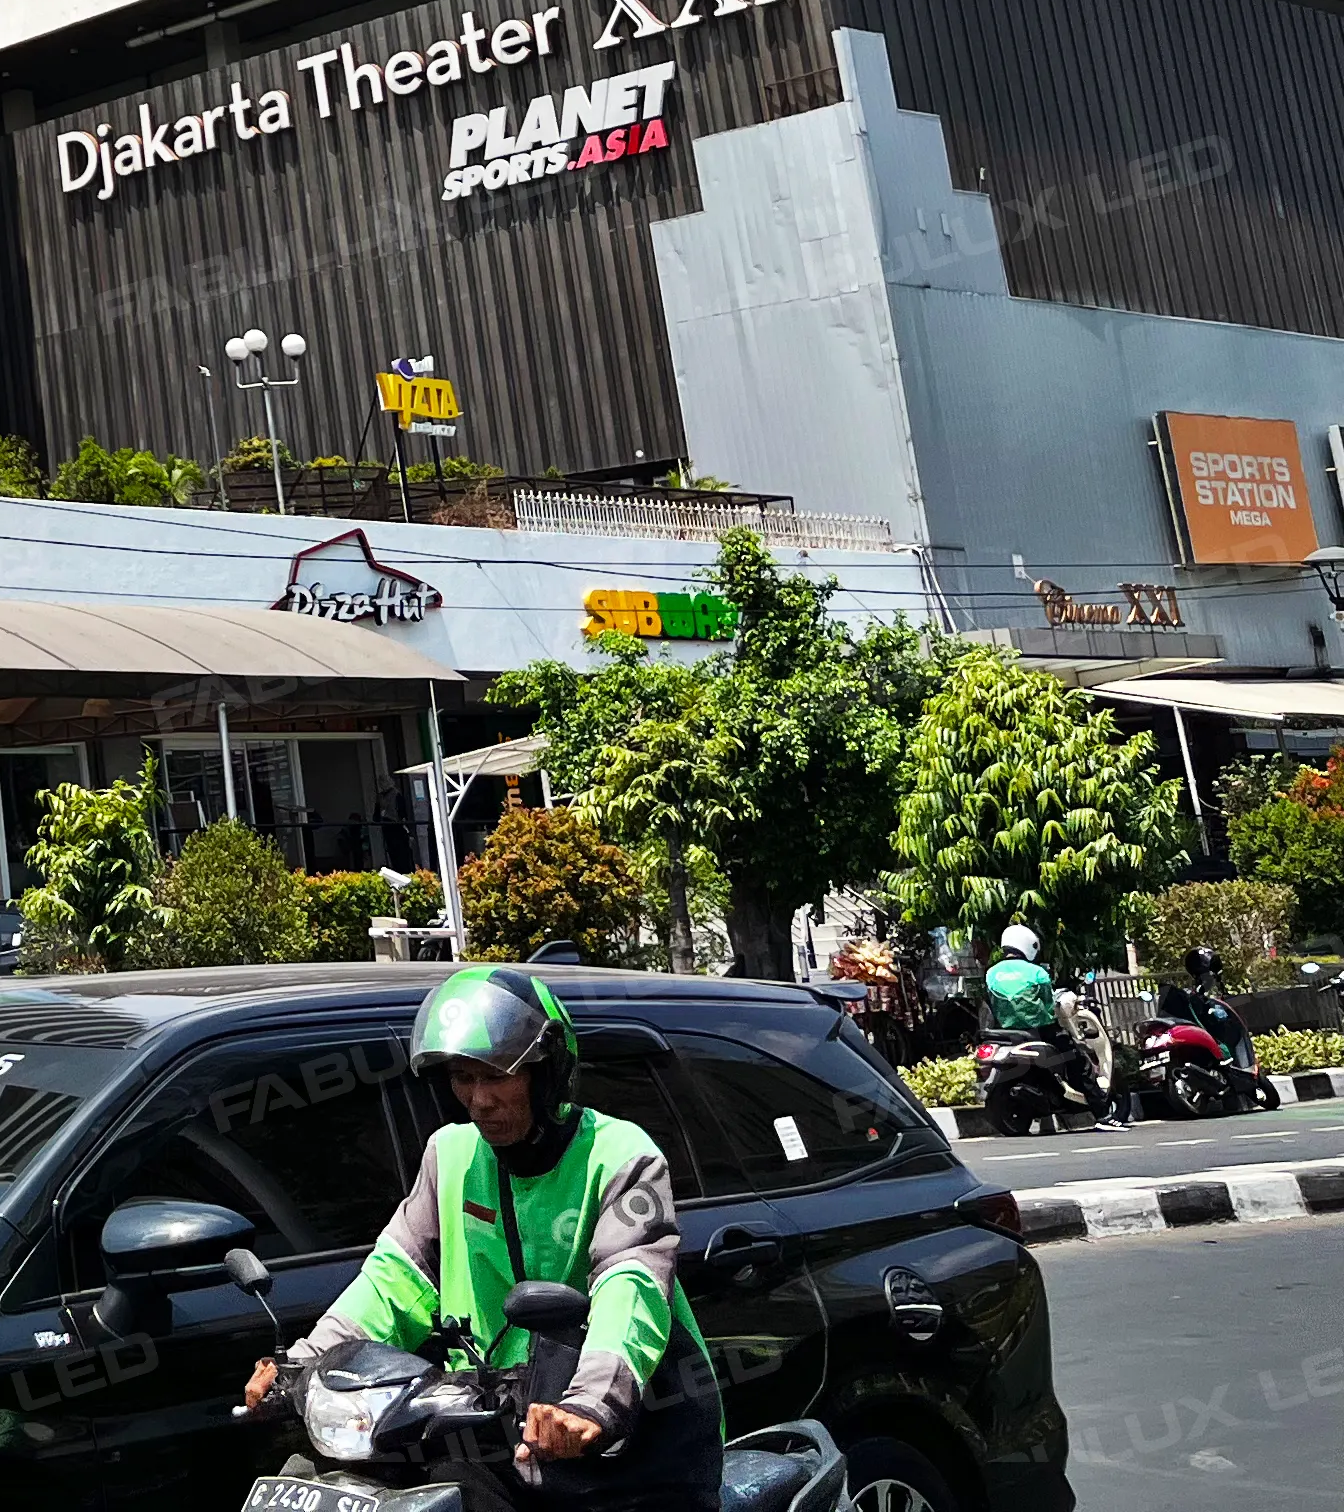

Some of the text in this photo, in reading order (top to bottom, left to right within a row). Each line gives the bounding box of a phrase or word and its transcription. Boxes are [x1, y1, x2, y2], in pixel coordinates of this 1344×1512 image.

[57, 82, 292, 201] Djakarta
[297, 4, 564, 121] Theater
[448, 61, 676, 169] PLANET
[1189, 451, 1291, 482] SPORTS
[1195, 479, 1297, 509] STATION
[1229, 510, 1273, 527] MEGA
[286, 577, 439, 627] Pizza Hut
[1117, 582, 1186, 628] XXI
